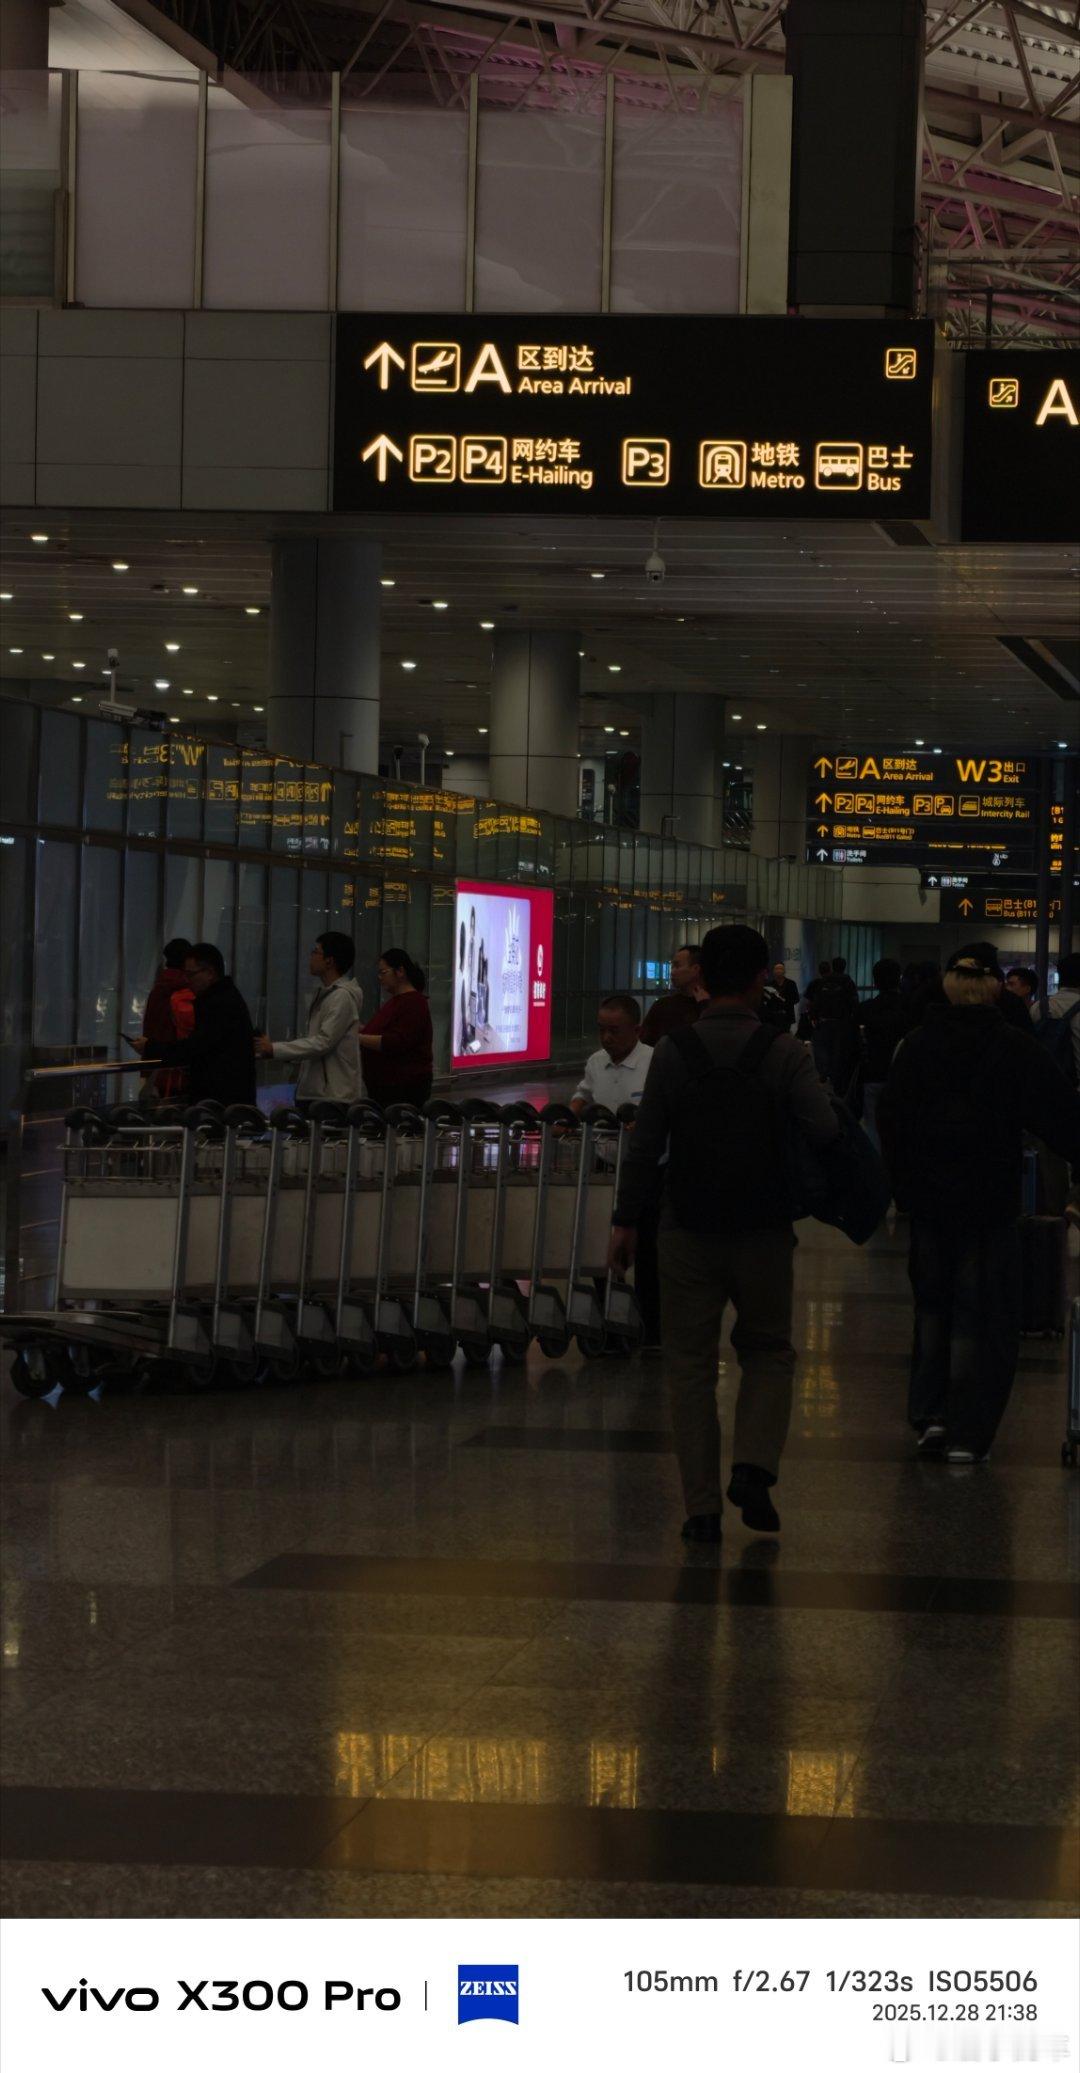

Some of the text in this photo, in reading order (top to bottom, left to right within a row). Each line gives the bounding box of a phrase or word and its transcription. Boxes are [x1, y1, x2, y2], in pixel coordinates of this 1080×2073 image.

[518, 345, 594, 372] 区到达
[464, 343, 512, 393] A
[518, 377, 631, 395] Area Arrival
[1036, 380, 1080, 425] A
[416, 444, 452, 475] P2
[512, 438, 580, 463] 网约车
[751, 442, 799, 466] 地铁
[867, 446, 913, 468] 巴士
[467, 445, 503, 476] P4
[628, 447, 665, 478] P3
[511, 465, 593, 489] E-Hailing
[751, 471, 805, 489] Metro
[868, 473, 901, 490] Bus
[858, 757, 881, 780] A
[883, 759, 917, 771] 区到达
[956, 759, 1003, 783] W3
[1004, 762, 1026, 773] 出口
[883, 772, 933, 781] Area Arrival
[1003, 774, 1020, 784] Exit
[837, 797, 853, 813] P2
[857, 797, 873, 813] P4
[914, 798, 931, 813] P3
[982, 796, 1026, 808] 城际列车
[875, 806, 911, 817] E-Hailing
[981, 810, 1030, 819] Intercity Rail
